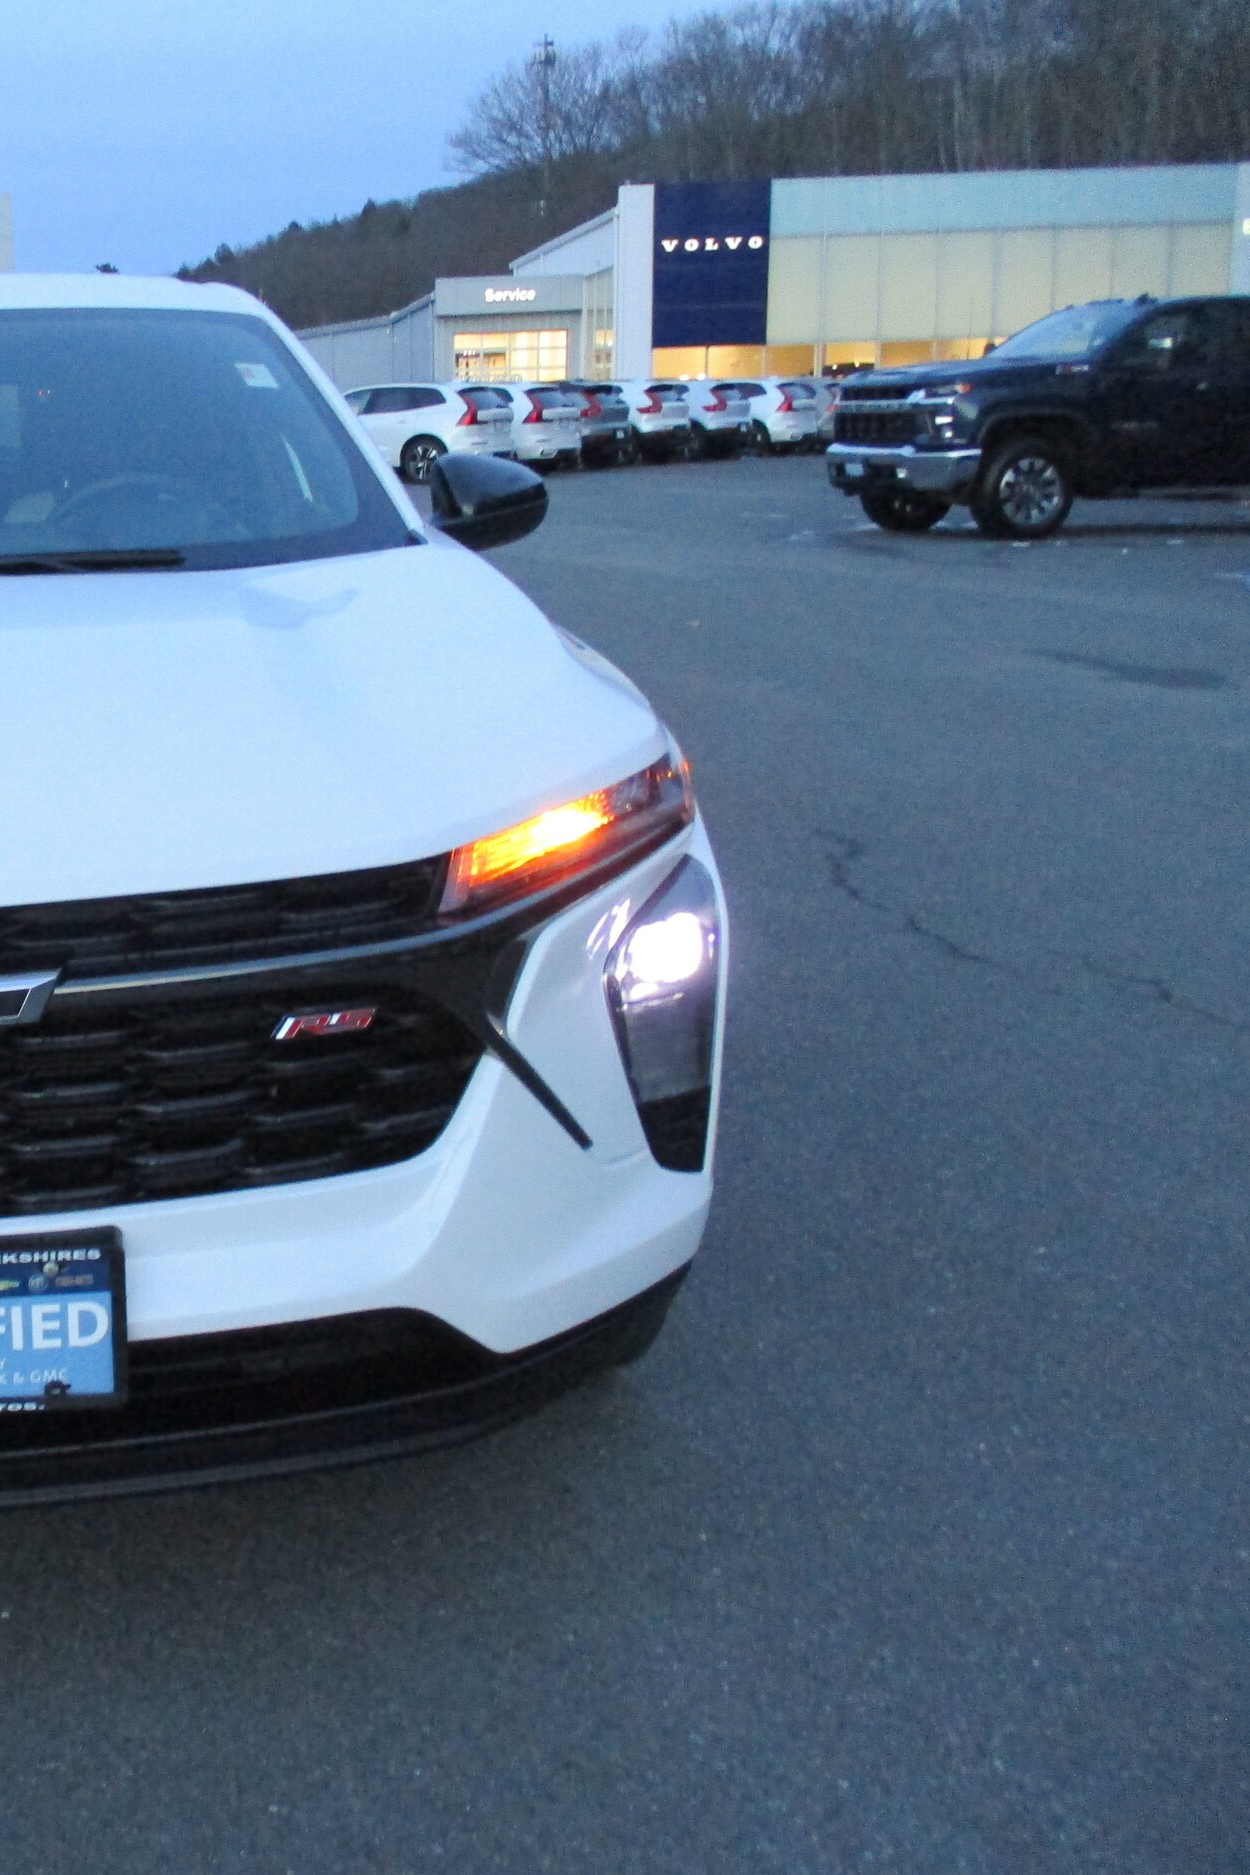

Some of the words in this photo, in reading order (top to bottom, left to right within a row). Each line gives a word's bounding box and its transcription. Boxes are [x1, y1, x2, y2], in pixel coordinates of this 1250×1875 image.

[660, 236, 763, 253] VOLVO
[484, 287, 536, 303] Service
[12, 1371, 24, 1384] &
[30, 1368, 68, 1382] GMC
